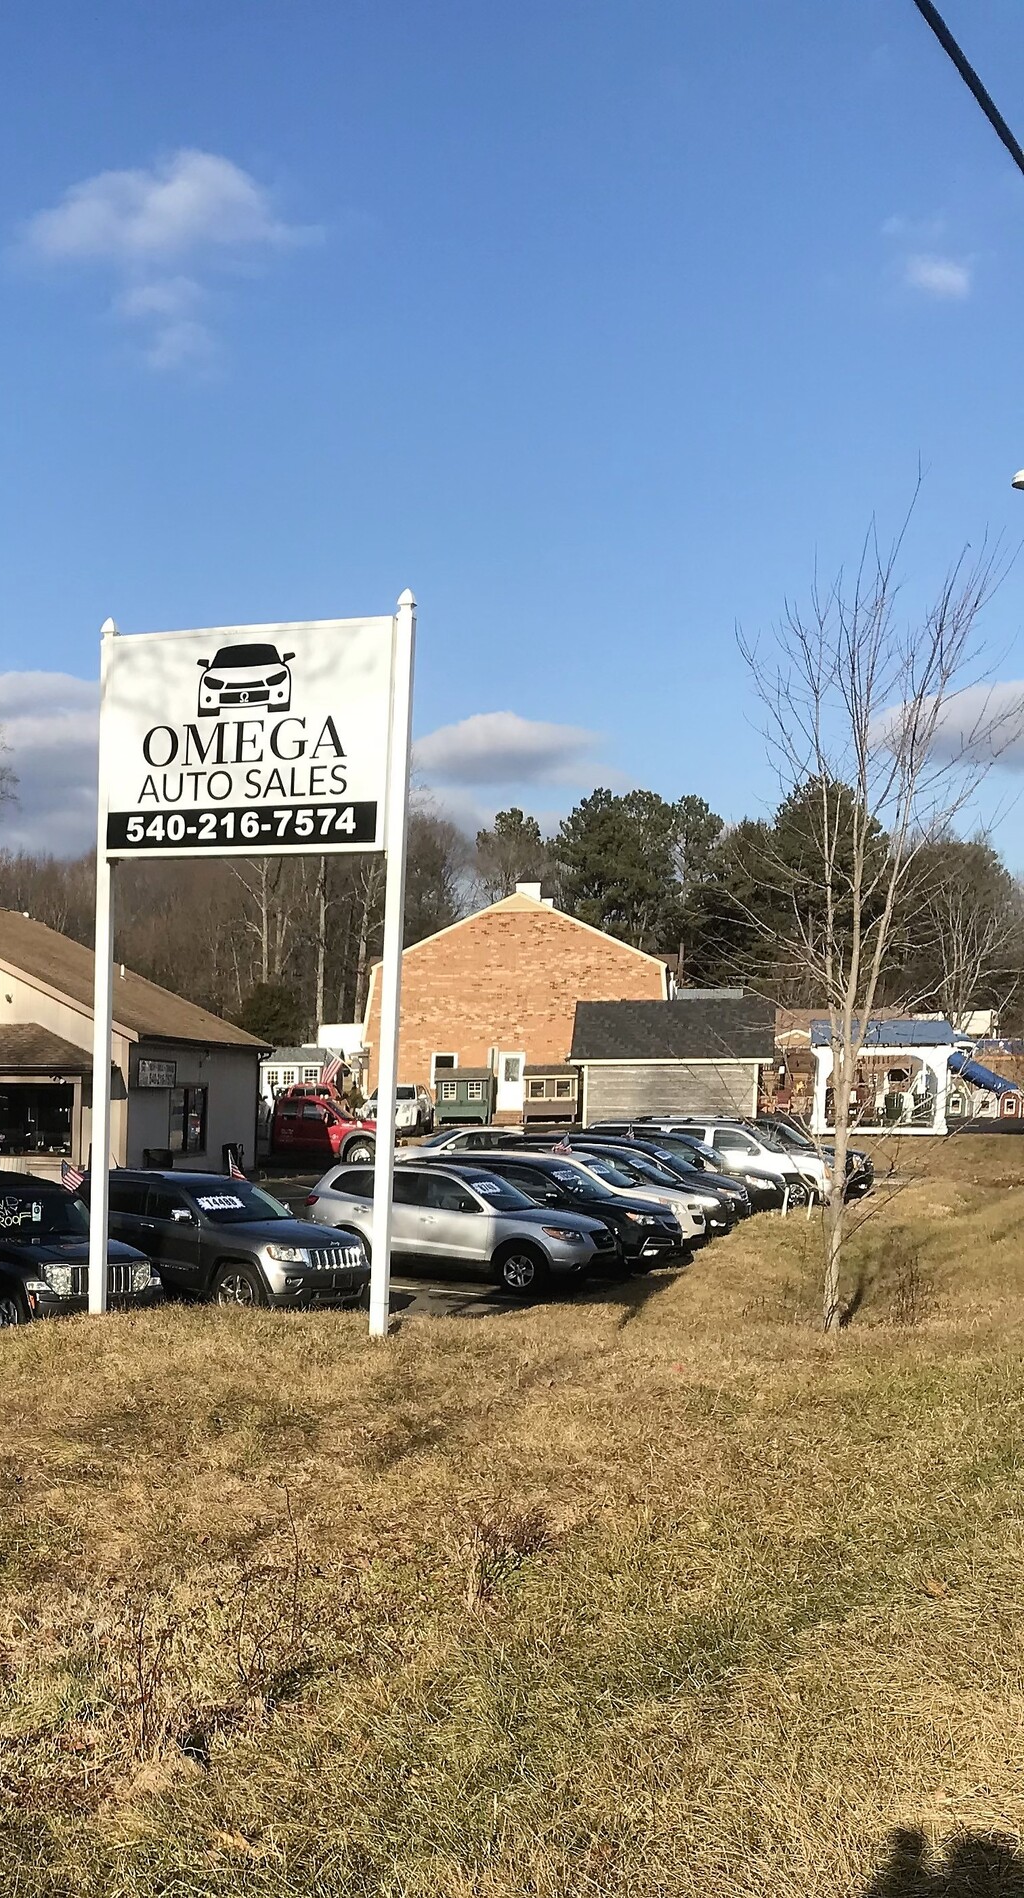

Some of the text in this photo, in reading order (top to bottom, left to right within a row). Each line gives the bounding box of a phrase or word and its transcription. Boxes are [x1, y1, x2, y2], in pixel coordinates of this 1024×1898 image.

[142, 715, 347, 768] OMEGA
[138, 764, 347, 804] AUTO SALES
[126, 806, 356, 842] 540-216-7574
